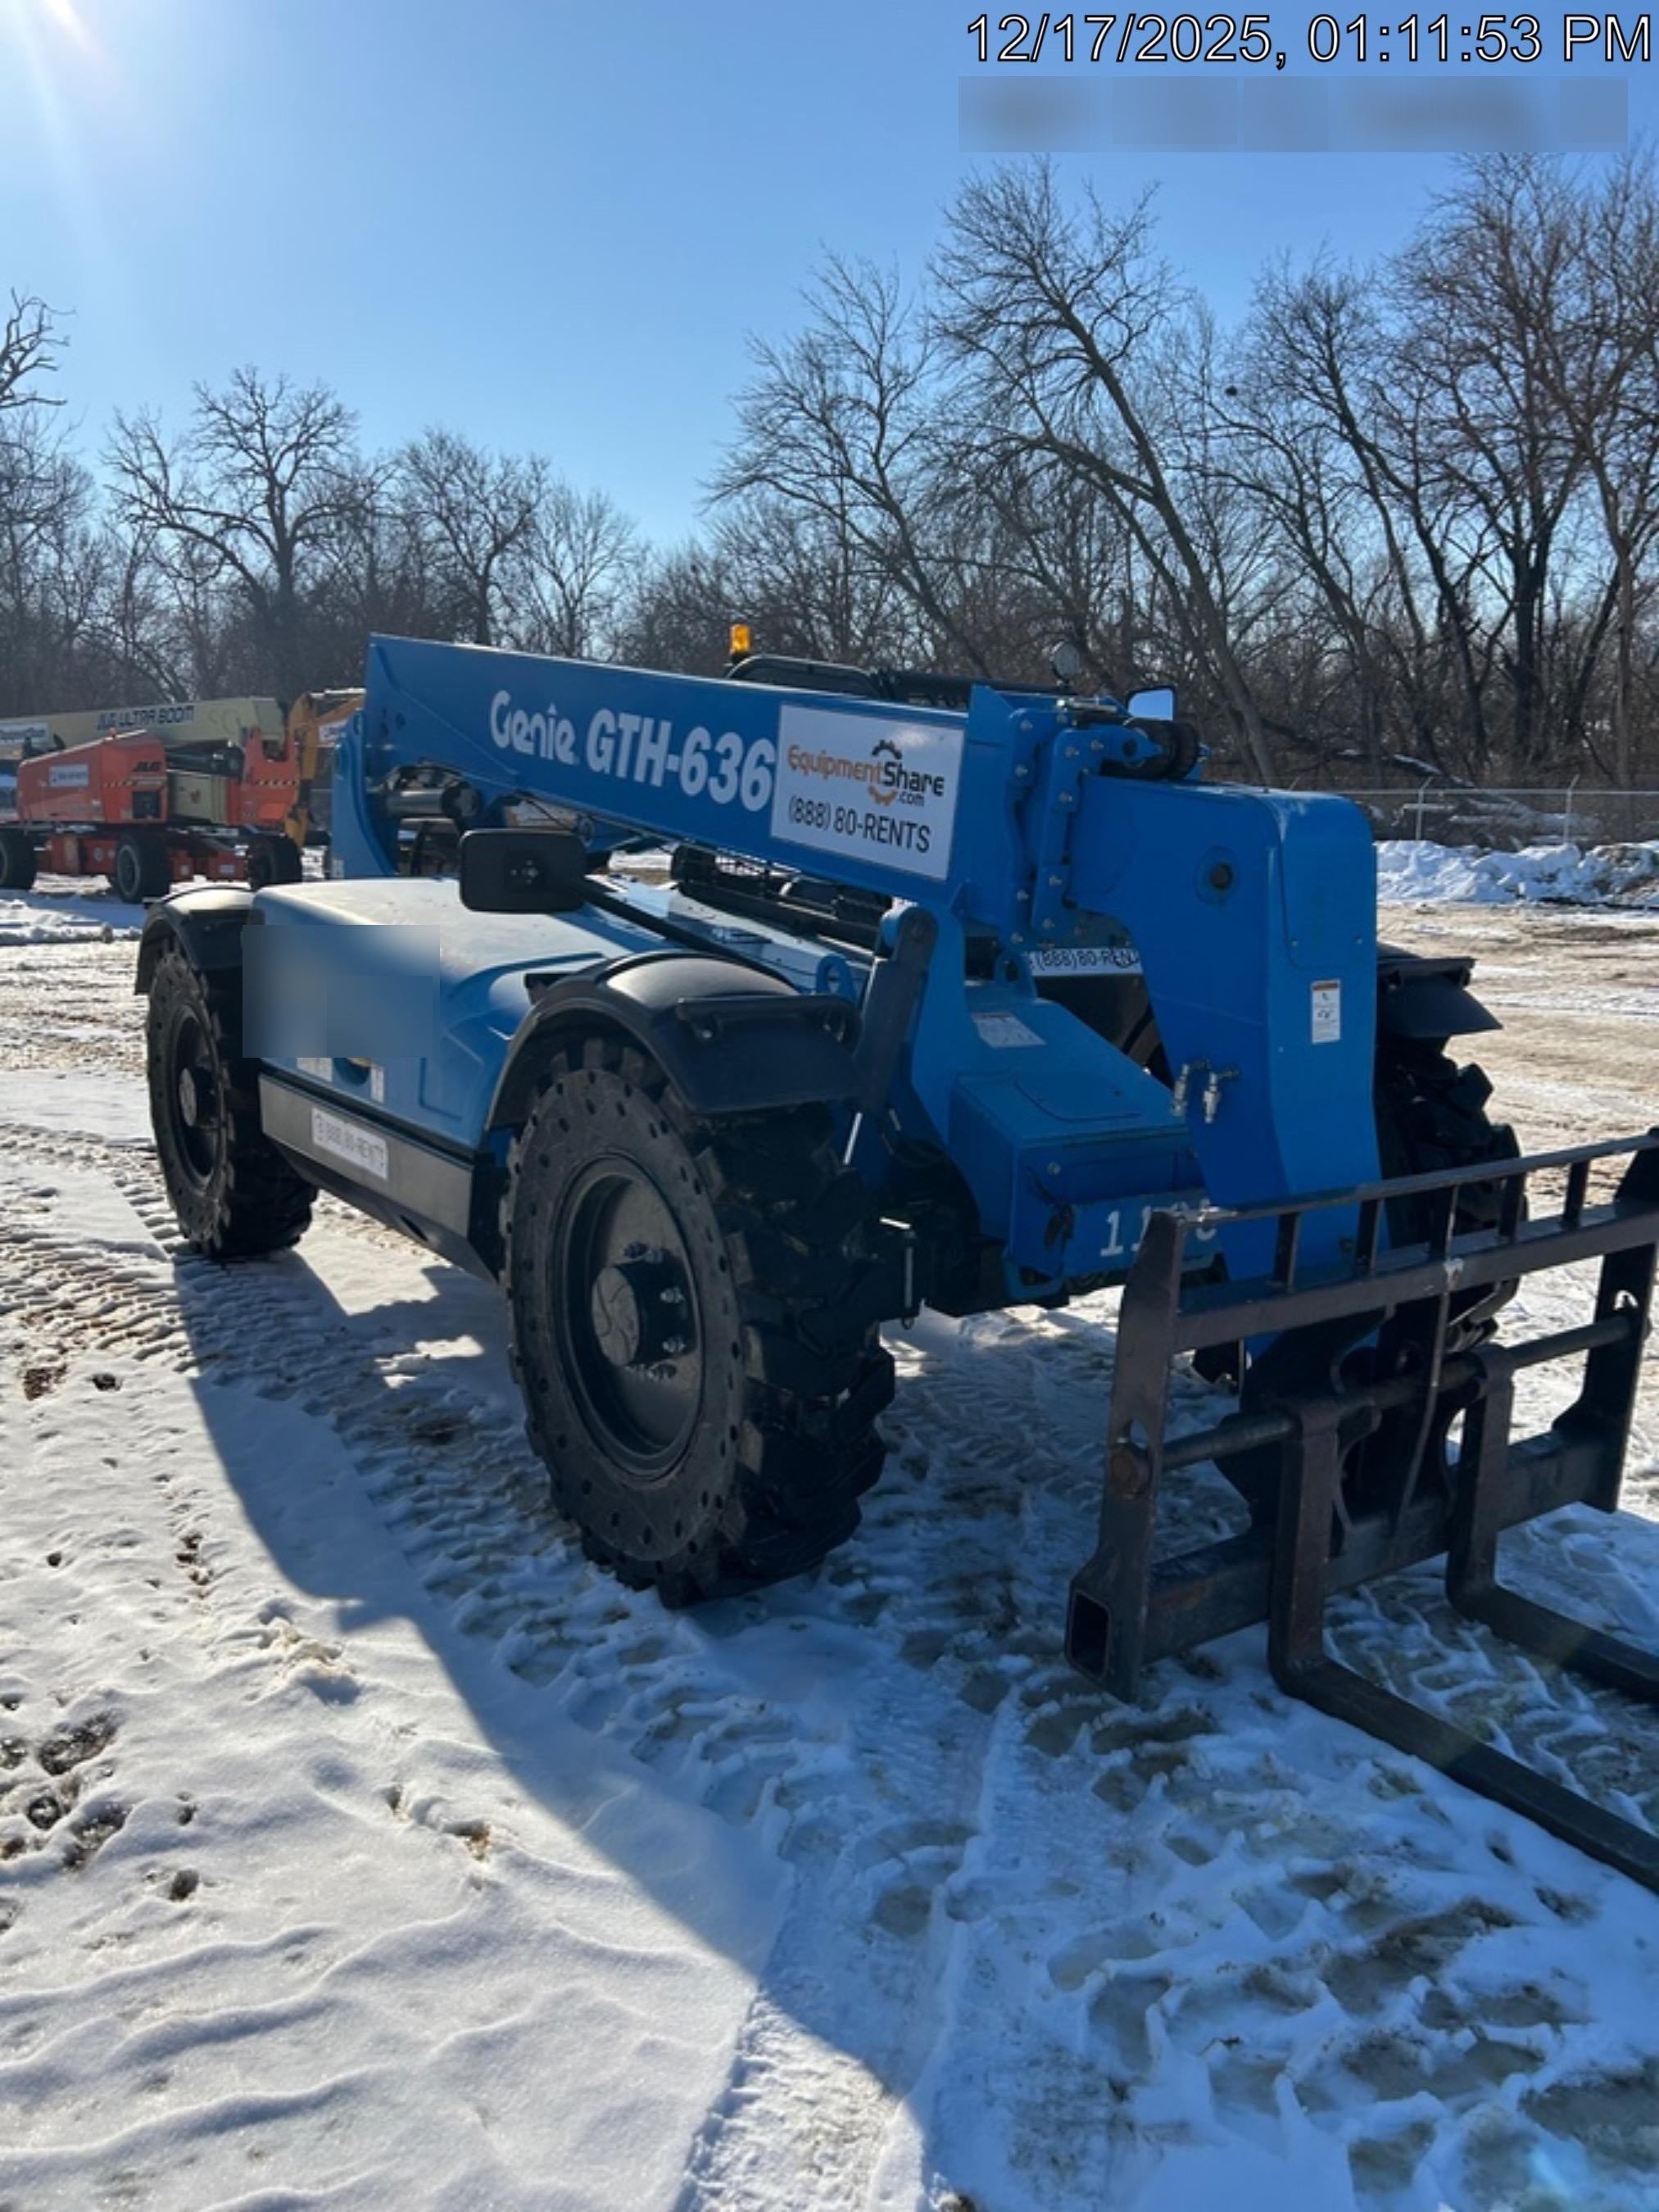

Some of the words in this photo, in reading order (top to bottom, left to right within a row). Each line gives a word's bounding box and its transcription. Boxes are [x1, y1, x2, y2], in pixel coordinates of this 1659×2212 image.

[118, 709, 156, 728] ULTRA
[158, 705, 195, 724] BOOM
[491, 690, 579, 765] Genie
[587, 708, 776, 812] GTH-636
[786, 744, 945, 797] EquipmentShare
[788, 795, 832, 831] (888)
[833, 805, 931, 854] 80-RENTS
